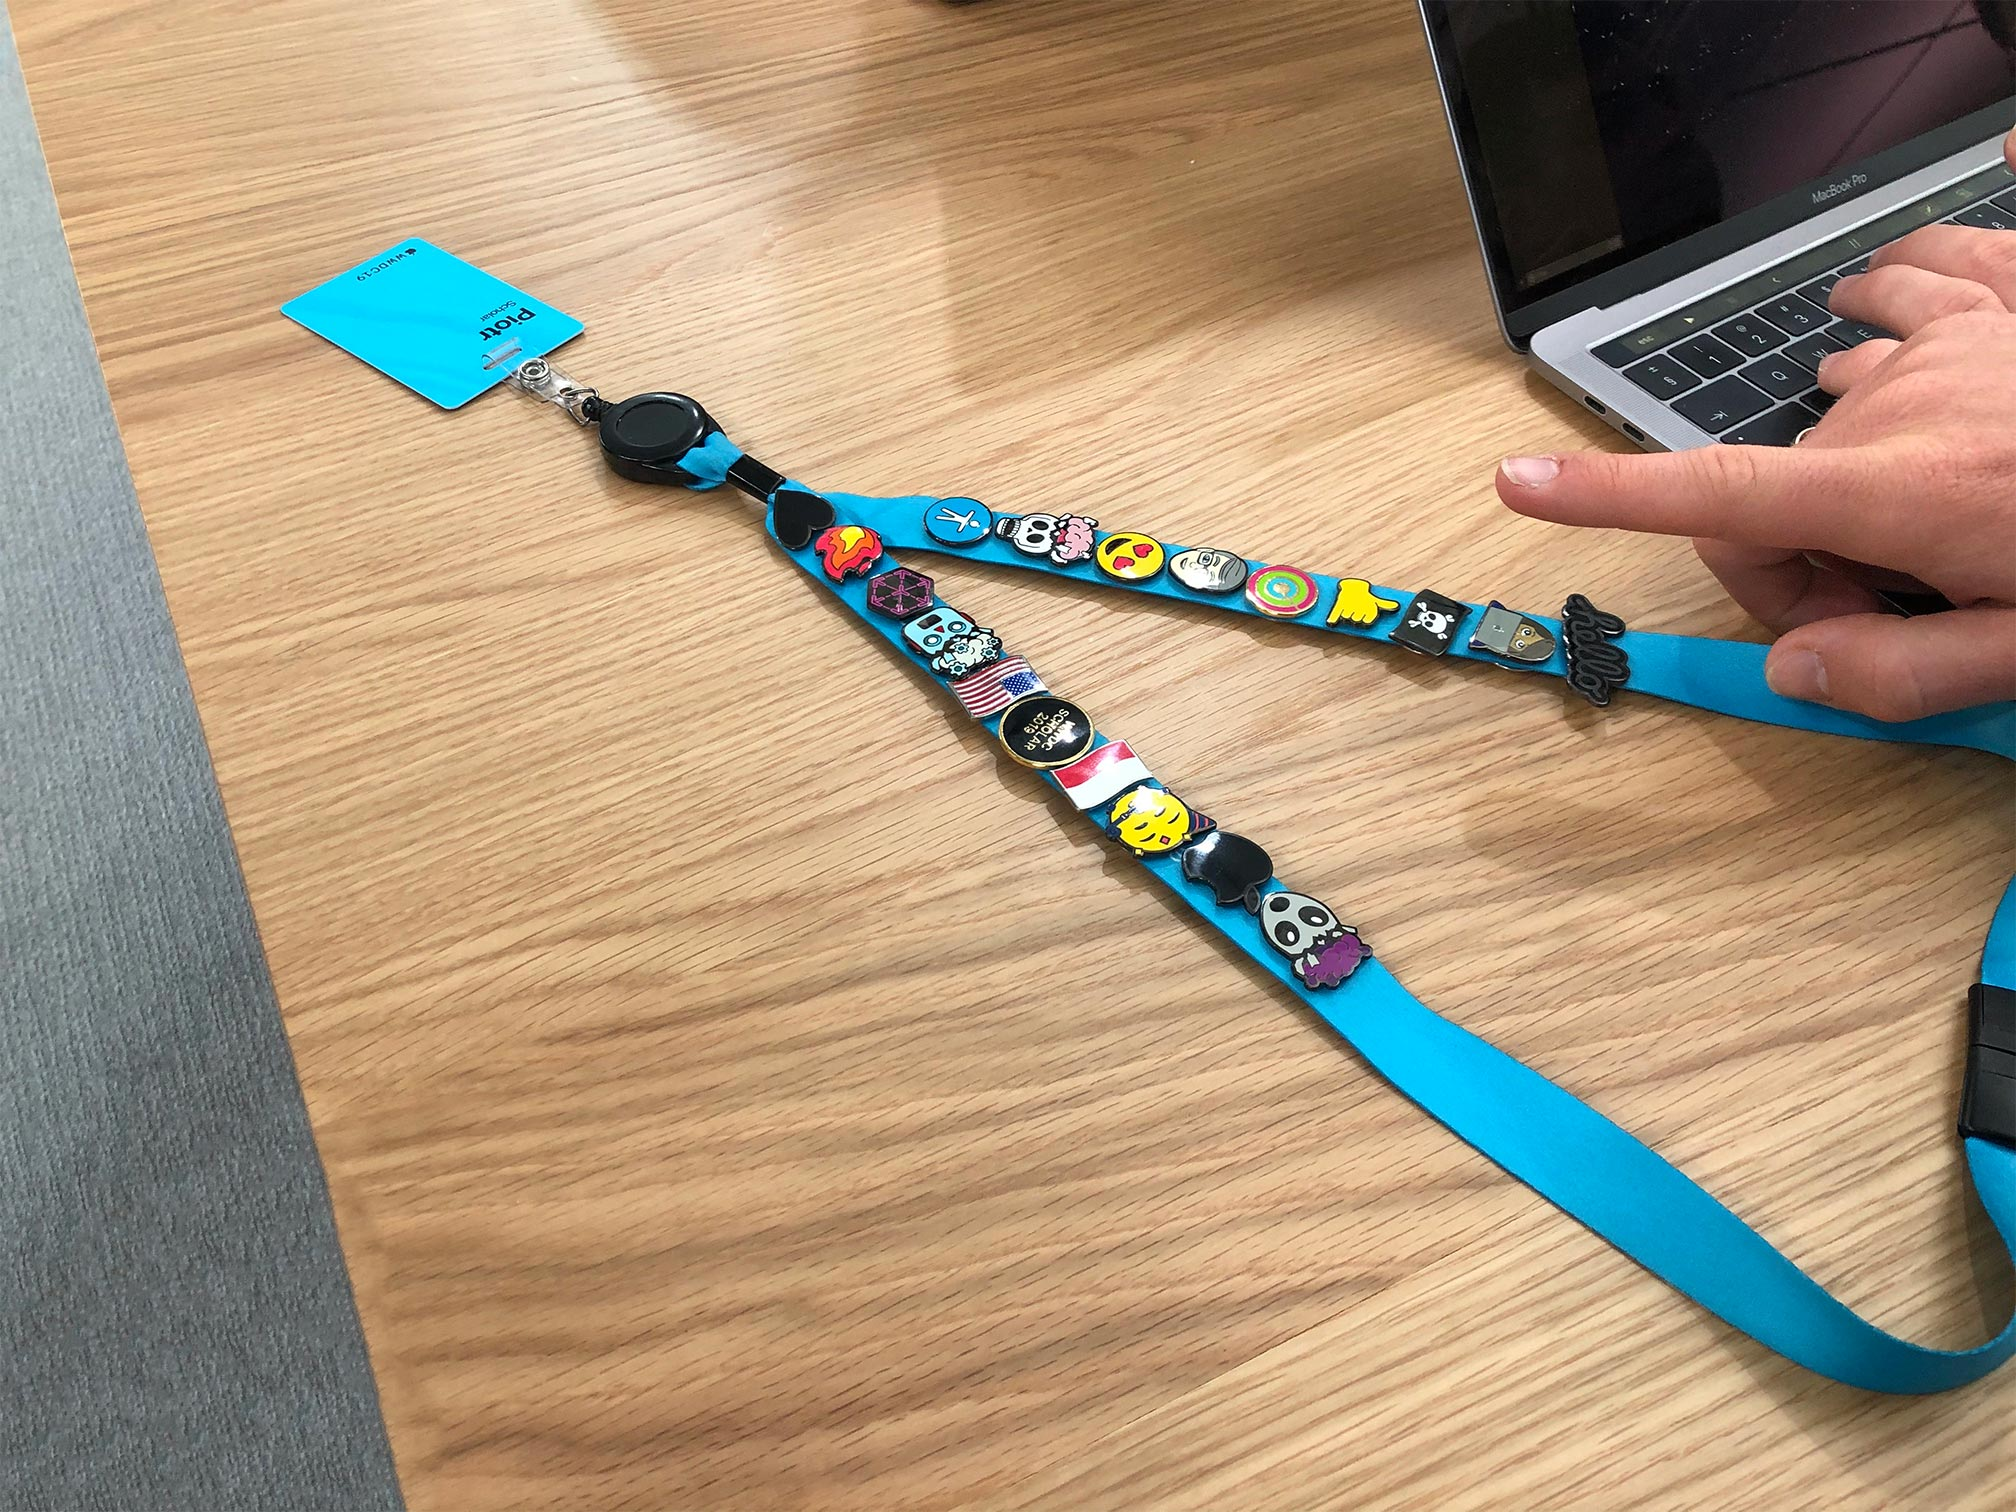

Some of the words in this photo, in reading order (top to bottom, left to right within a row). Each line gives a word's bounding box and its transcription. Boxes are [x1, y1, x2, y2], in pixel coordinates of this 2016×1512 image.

[1811, 179, 1852, 204] MacBook
[1852, 173, 1868, 187] Pro
[356, 253, 408, 281] WWDC19
[480, 300, 517, 322] Scholar
[1794, 314, 1809, 324] 3
[479, 307, 537, 341] Piotr
[1637, 335, 1655, 346] esc
[1751, 333, 1768, 345] 2
[1856, 328, 1873, 339] E
[1708, 355, 1722, 364] 1
[1811, 348, 1829, 359] W
[1771, 370, 1790, 381] Q
[1564, 596, 1627, 704] hello
[1023, 711, 1049, 734] 2019
[1023, 708, 1070, 751] SCHOLAR
